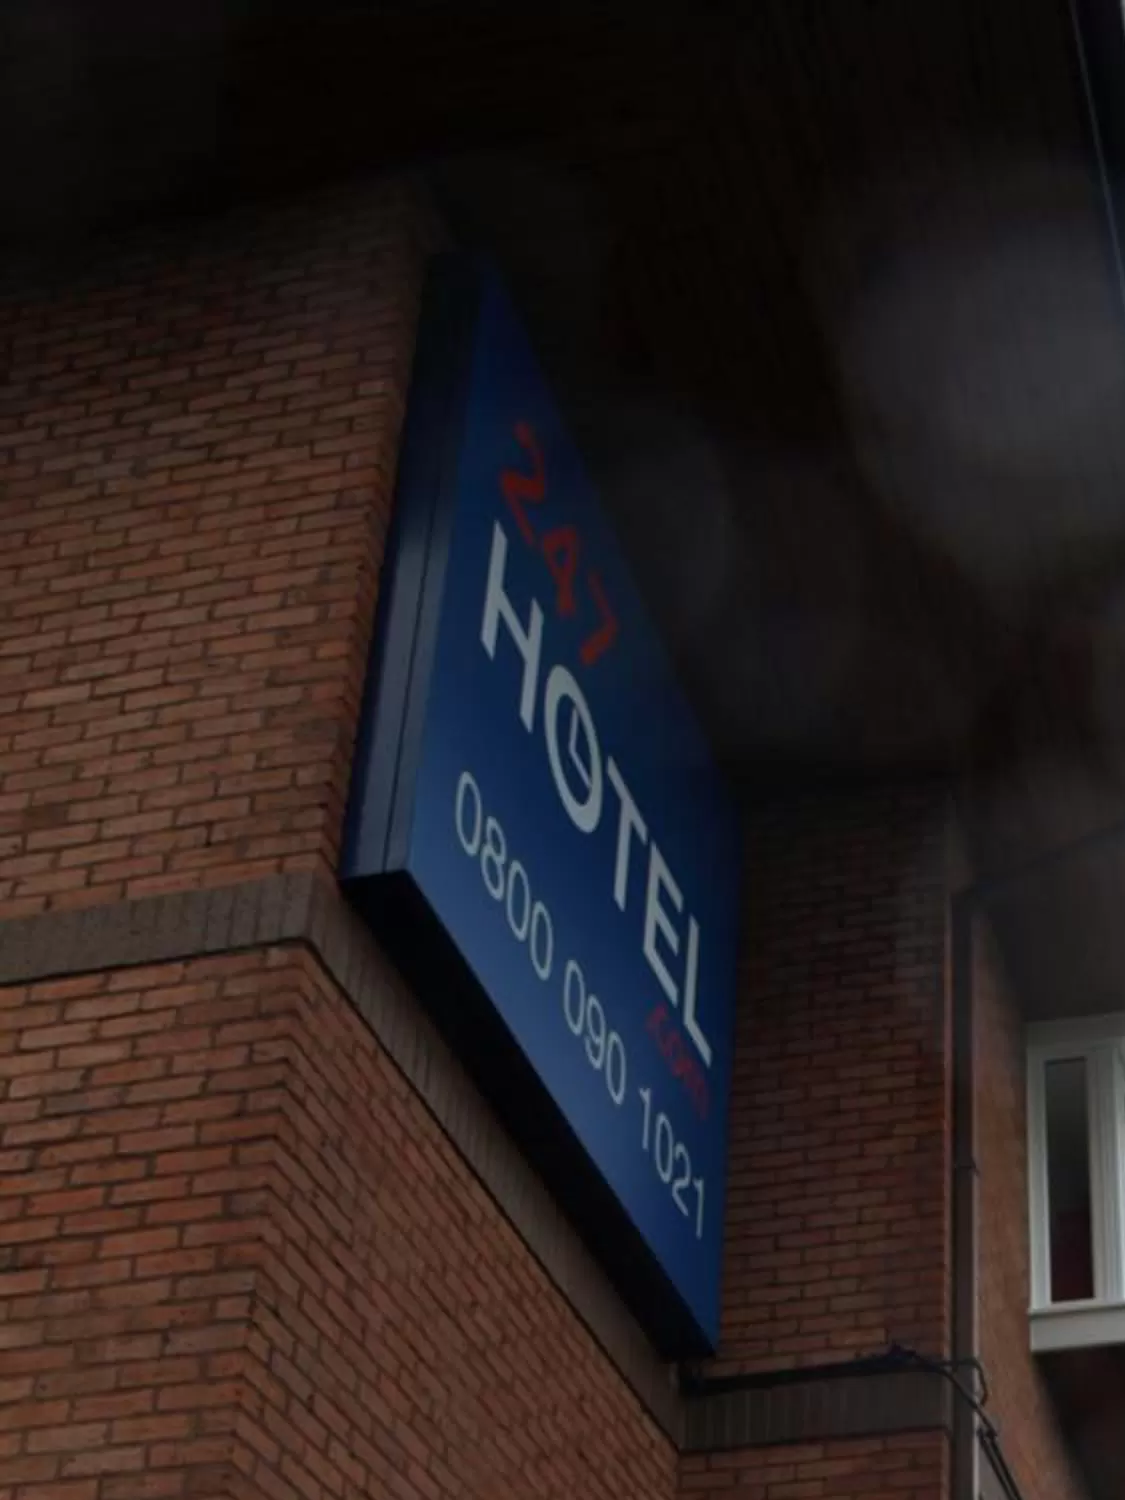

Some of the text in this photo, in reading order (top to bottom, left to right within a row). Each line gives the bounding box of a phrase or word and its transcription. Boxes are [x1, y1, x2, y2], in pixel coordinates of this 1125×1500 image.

[500, 421, 618, 664] 247
[455, 772, 704, 1239] 0800 090 1021
[481, 520, 713, 1067] HOTEL
